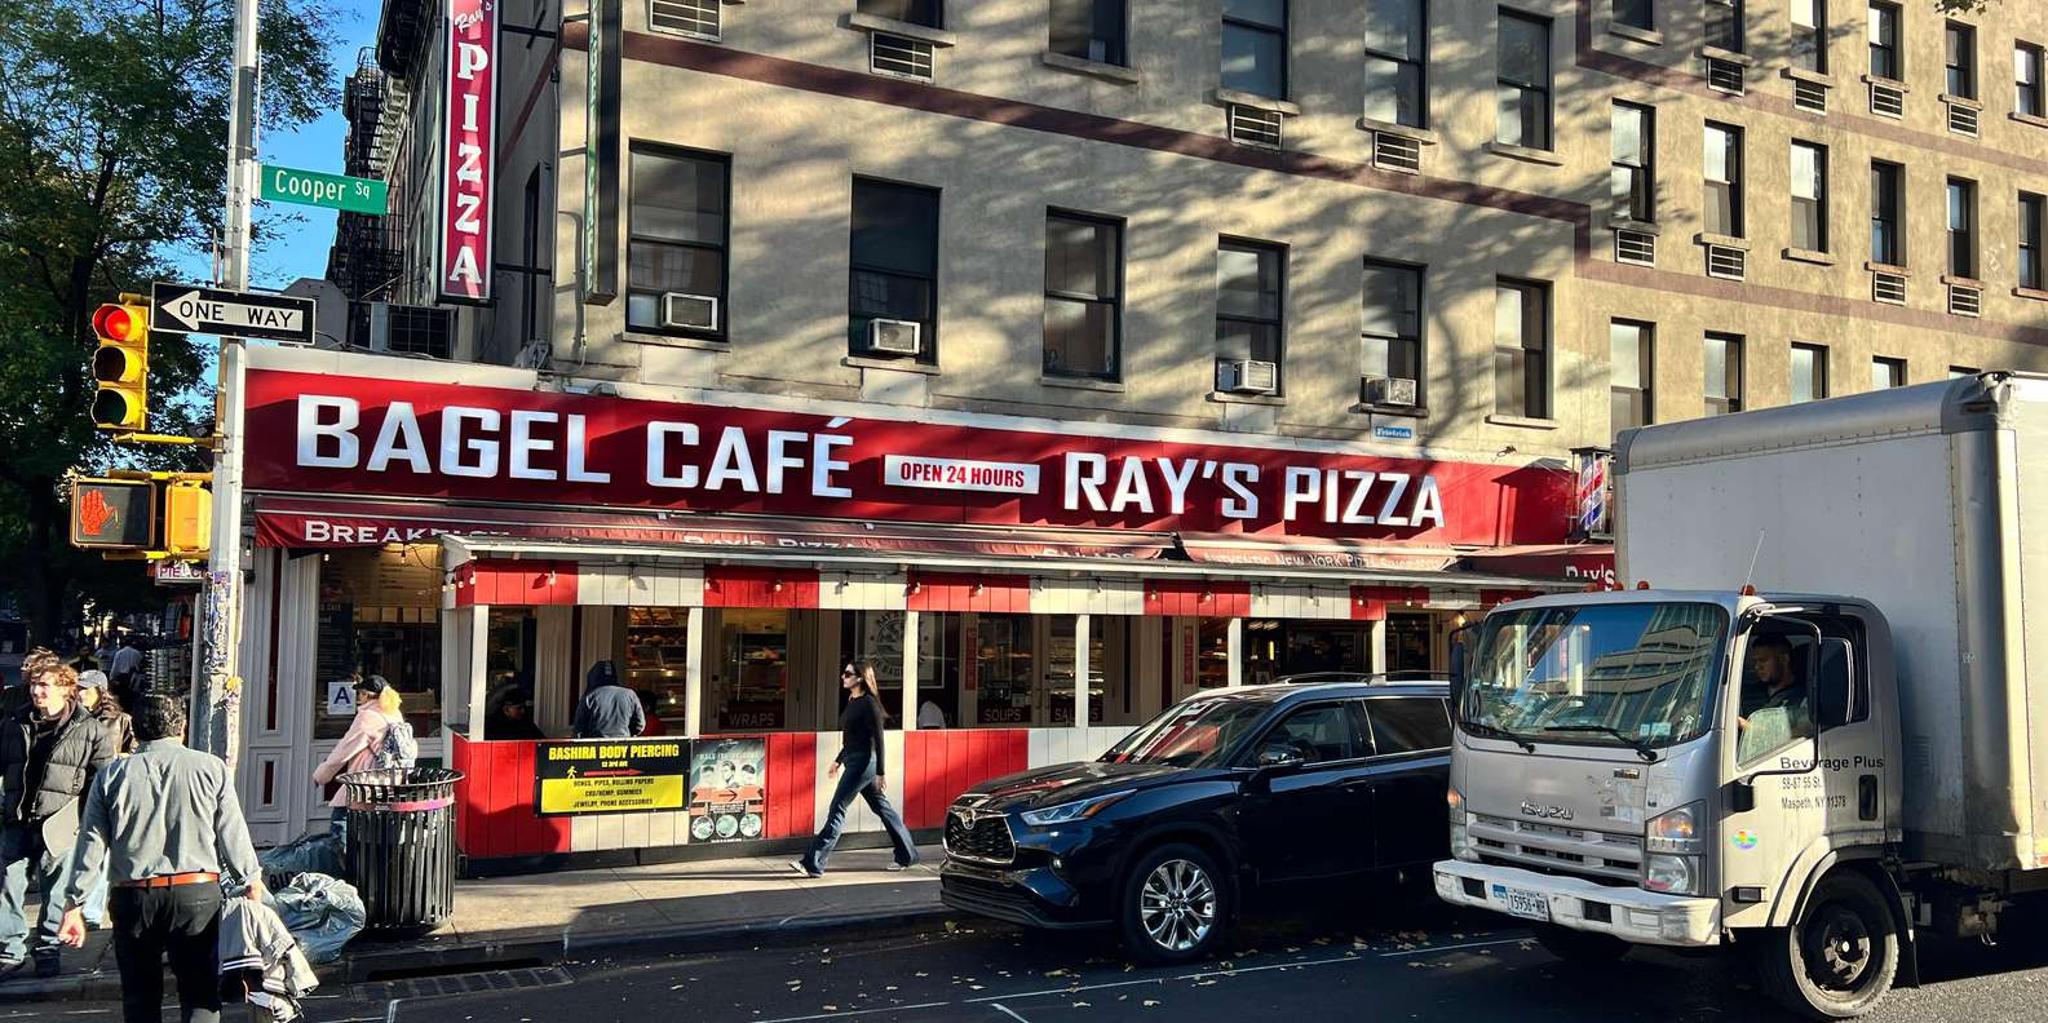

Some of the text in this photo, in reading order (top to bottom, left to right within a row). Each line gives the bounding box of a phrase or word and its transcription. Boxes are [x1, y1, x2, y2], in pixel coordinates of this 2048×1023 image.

[449, 41, 489, 284] PIZZA
[275, 169, 370, 203] Cooper Sq
[180, 300, 293, 328] ONE WAY
[296, 393, 854, 498] BAGEL CAFÉ
[901, 462, 1025, 488] OPEN 24 HOURS
[1064, 451, 1446, 528] RAY'S PIZZA
[1309, 553, 1343, 567] YORK
[333, 686, 351, 705] A
[729, 712, 776, 726] WRAPS
[984, 707, 1022, 722] SOUPS
[1054, 707, 1099, 721] SALS
[548, 746, 597, 760] BASHIRA
[599, 745, 629, 759] BODY
[630, 743, 680, 758] PIERCING
[1853, 755, 1884, 768] Plus
[1521, 801, 1575, 821] ISUZU
